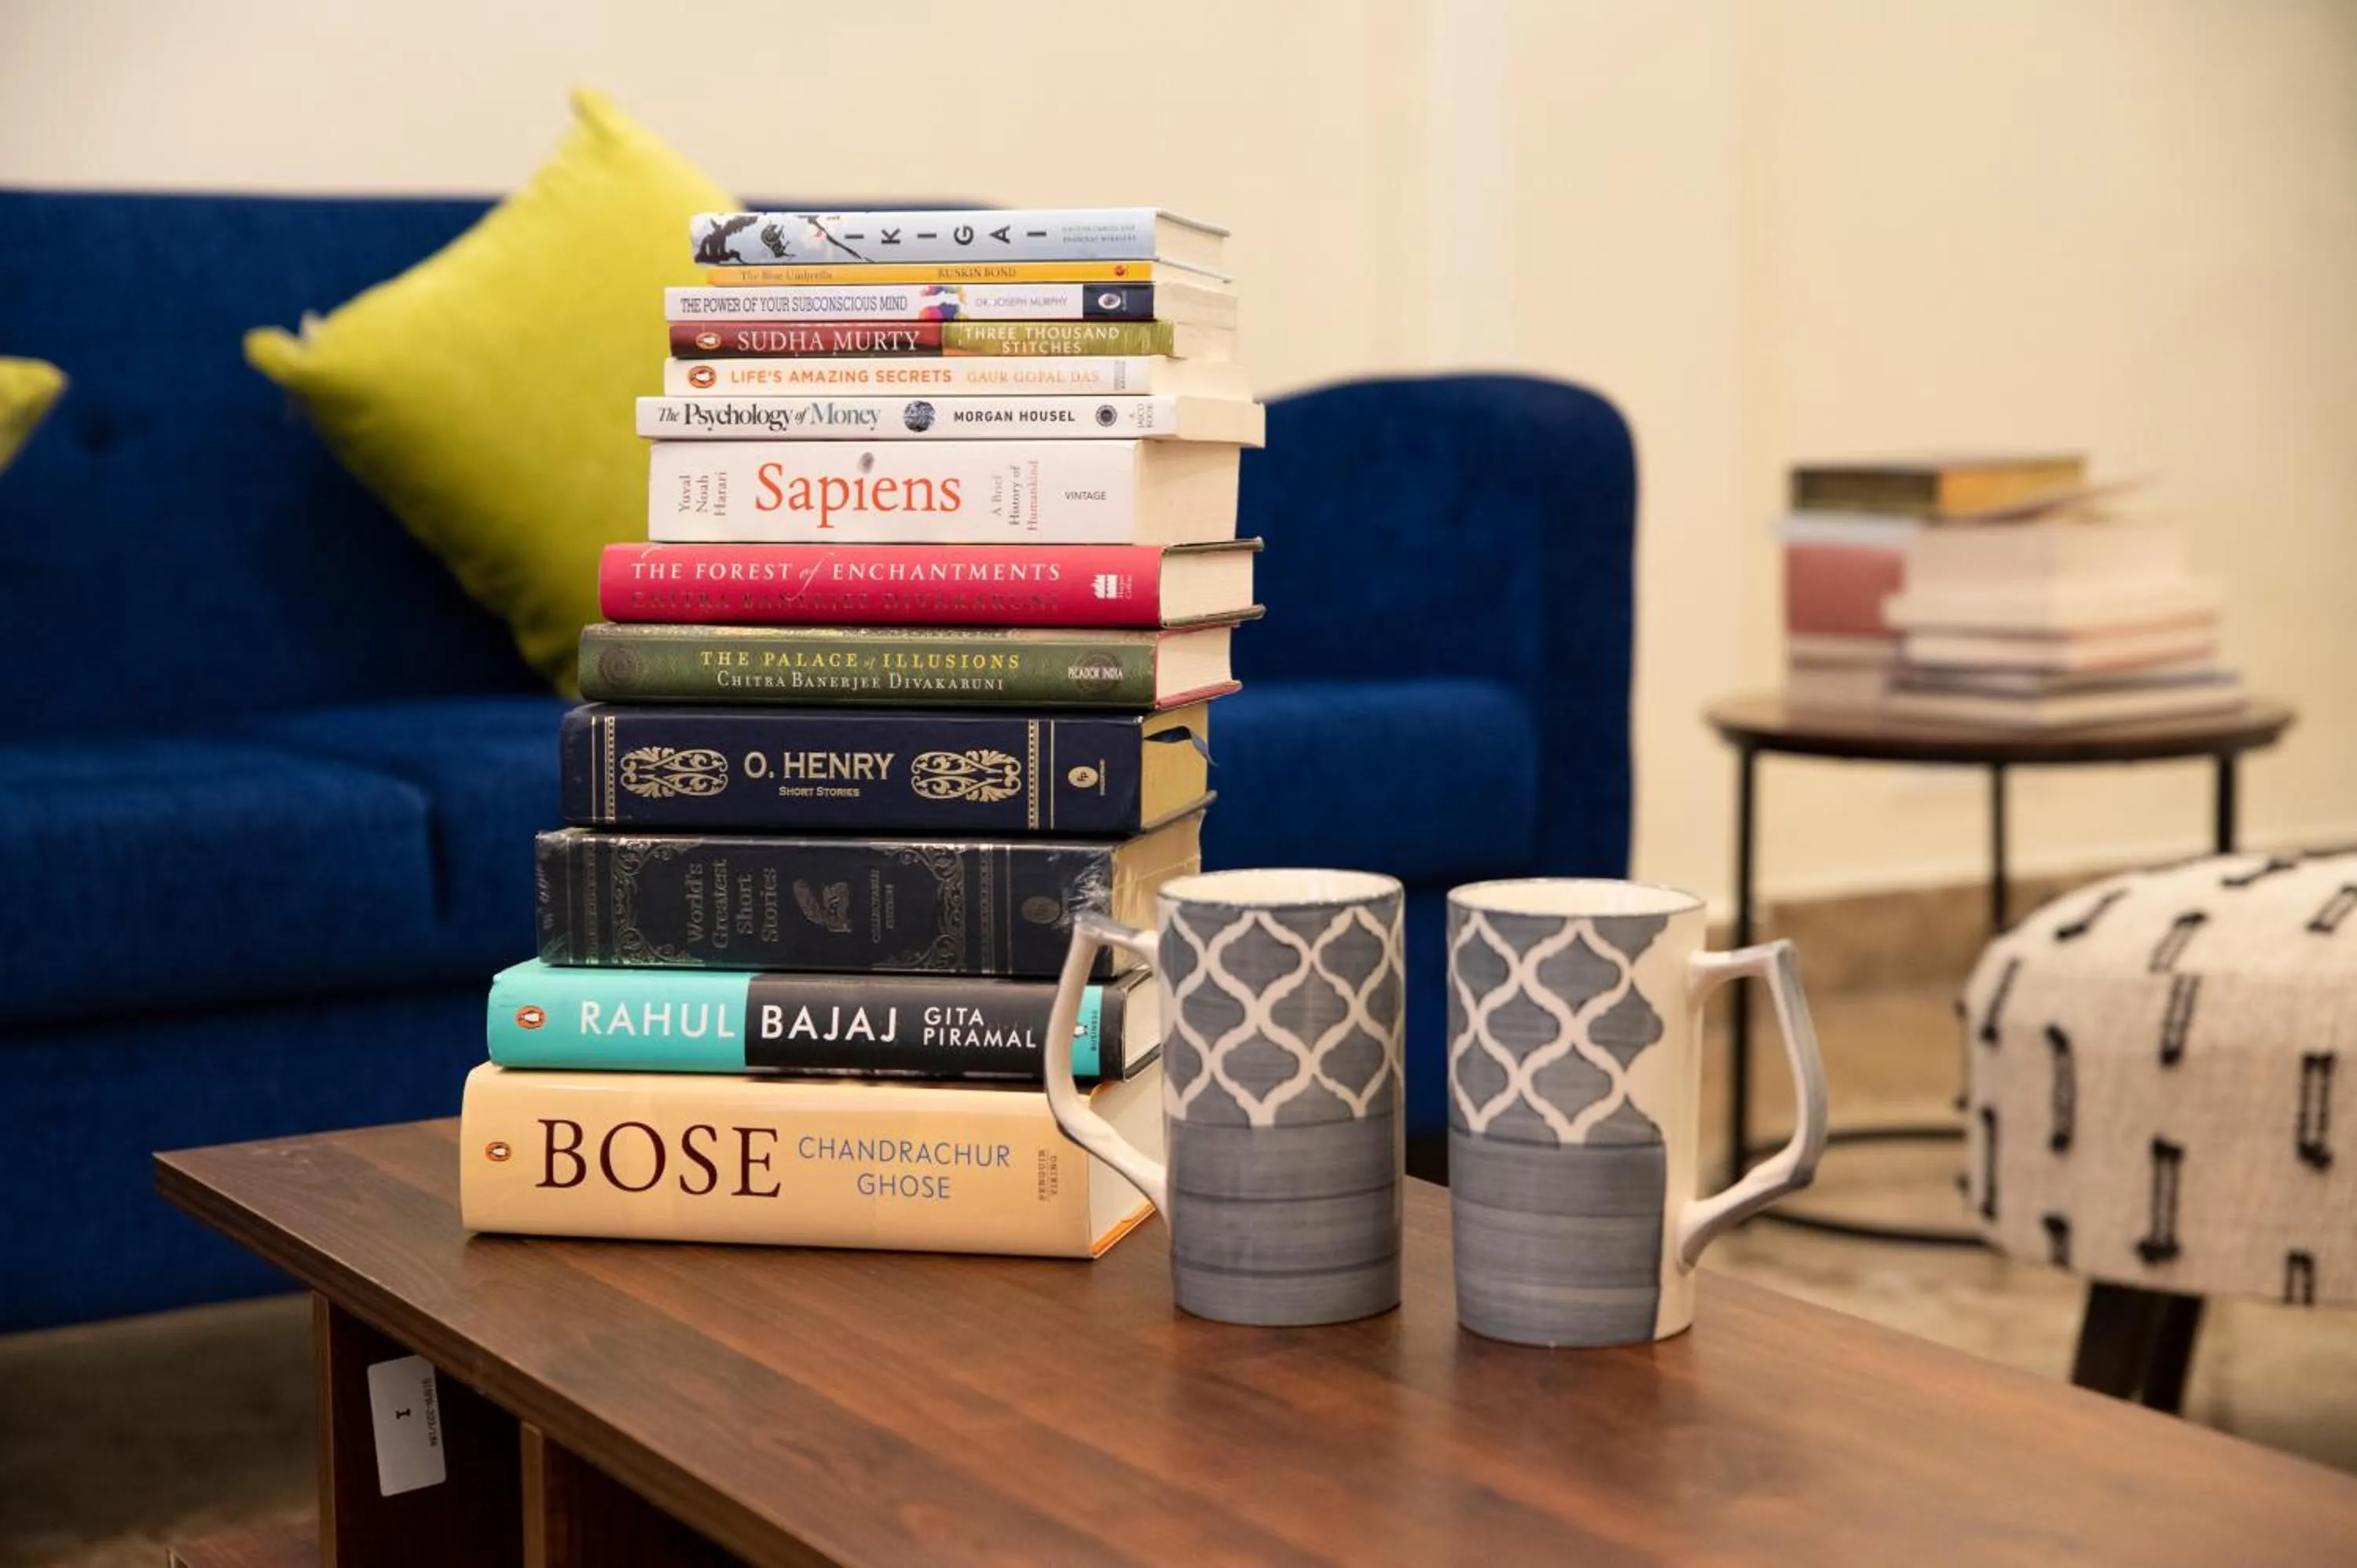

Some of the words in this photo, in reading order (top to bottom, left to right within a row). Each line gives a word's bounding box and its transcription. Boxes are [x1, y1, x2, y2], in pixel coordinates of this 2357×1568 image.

[845, 225, 1047, 246] IKIGAI
[938, 267, 981, 278] RUSKIN
[984, 266, 1016, 277] BOND
[680, 298, 701, 313] THE
[703, 298, 740, 313] POWER
[743, 298, 757, 312] OF
[760, 297, 790, 313] YOUR
[792, 295, 878, 312] SUBCONSCIOUS
[880, 295, 907, 311] MIND
[994, 297, 1027, 307] JOSEPH
[1030, 297, 1068, 307] MURPHY
[737, 330, 824, 351] SUDHA
[833, 330, 920, 350] MURTY
[965, 327, 1016, 339] THREE
[1026, 326, 1120, 340] THOUSAND
[1002, 341, 1082, 354] STITCHES
[731, 370, 783, 383] LIFE'S
[789, 370, 869, 383] AMAZING
[875, 369, 951, 383] SECRETS
[966, 370, 1008, 383] GAUR
[1014, 370, 1063, 383] GOPAL
[1070, 370, 1100, 383] DAS
[658, 406, 680, 423] The
[684, 403, 791, 431] Psychology
[794, 406, 810, 425] of
[809, 402, 881, 431] Money
[954, 411, 1013, 423] MORGAN
[1019, 410, 1076, 423] HOUSEL
[1009, 464, 1020, 478] of
[678, 474, 691, 513] Yuval
[695, 474, 709, 513] Noah
[713, 471, 728, 517] Harari
[755, 462, 962, 529] Sapiens
[1008, 481, 1023, 526] History
[1026, 460, 1038, 531] Humankind
[1065, 491, 1106, 501] VINTAGE
[992, 507, 1002, 516] A
[632, 562, 682, 580] THE
[695, 562, 793, 580] FOREST
[786, 551, 836, 602] of
[832, 562, 1061, 581] ENCHANTMENTS
[632, 592, 730, 609] CHITRA
[742, 592, 869, 610] BANERJEE
[882, 592, 1058, 612] DIVAKARUNI
[701, 651, 749, 666] THE
[763, 652, 858, 668] PALACE
[863, 656, 876, 670] of
[882, 654, 1020, 669] ILLUSIONS
[717, 671, 786, 687] CHITRA
[1068, 666, 1100, 680] PICADOR
[1102, 667, 1124, 680] INDIA
[743, 751, 775, 779] O.
[783, 751, 895, 780] HENRY
[779, 786, 814, 797] SHORT
[816, 786, 860, 797] STORIES
[687, 862, 705, 943] World's
[711, 859, 729, 949] Greatest
[735, 869, 753, 936] Short
[761, 866, 779, 943] Stories
[581, 1000, 735, 1039] RAHUL
[761, 1005, 897, 1042] BAJAJ
[923, 1006, 984, 1027] GITA
[923, 1027, 1037, 1049] PIRAMAL
[535, 1119, 781, 1197] BOSE
[799, 1137, 1011, 1168] CHANDRACHUR
[858, 1173, 951, 1200] GHOSE
